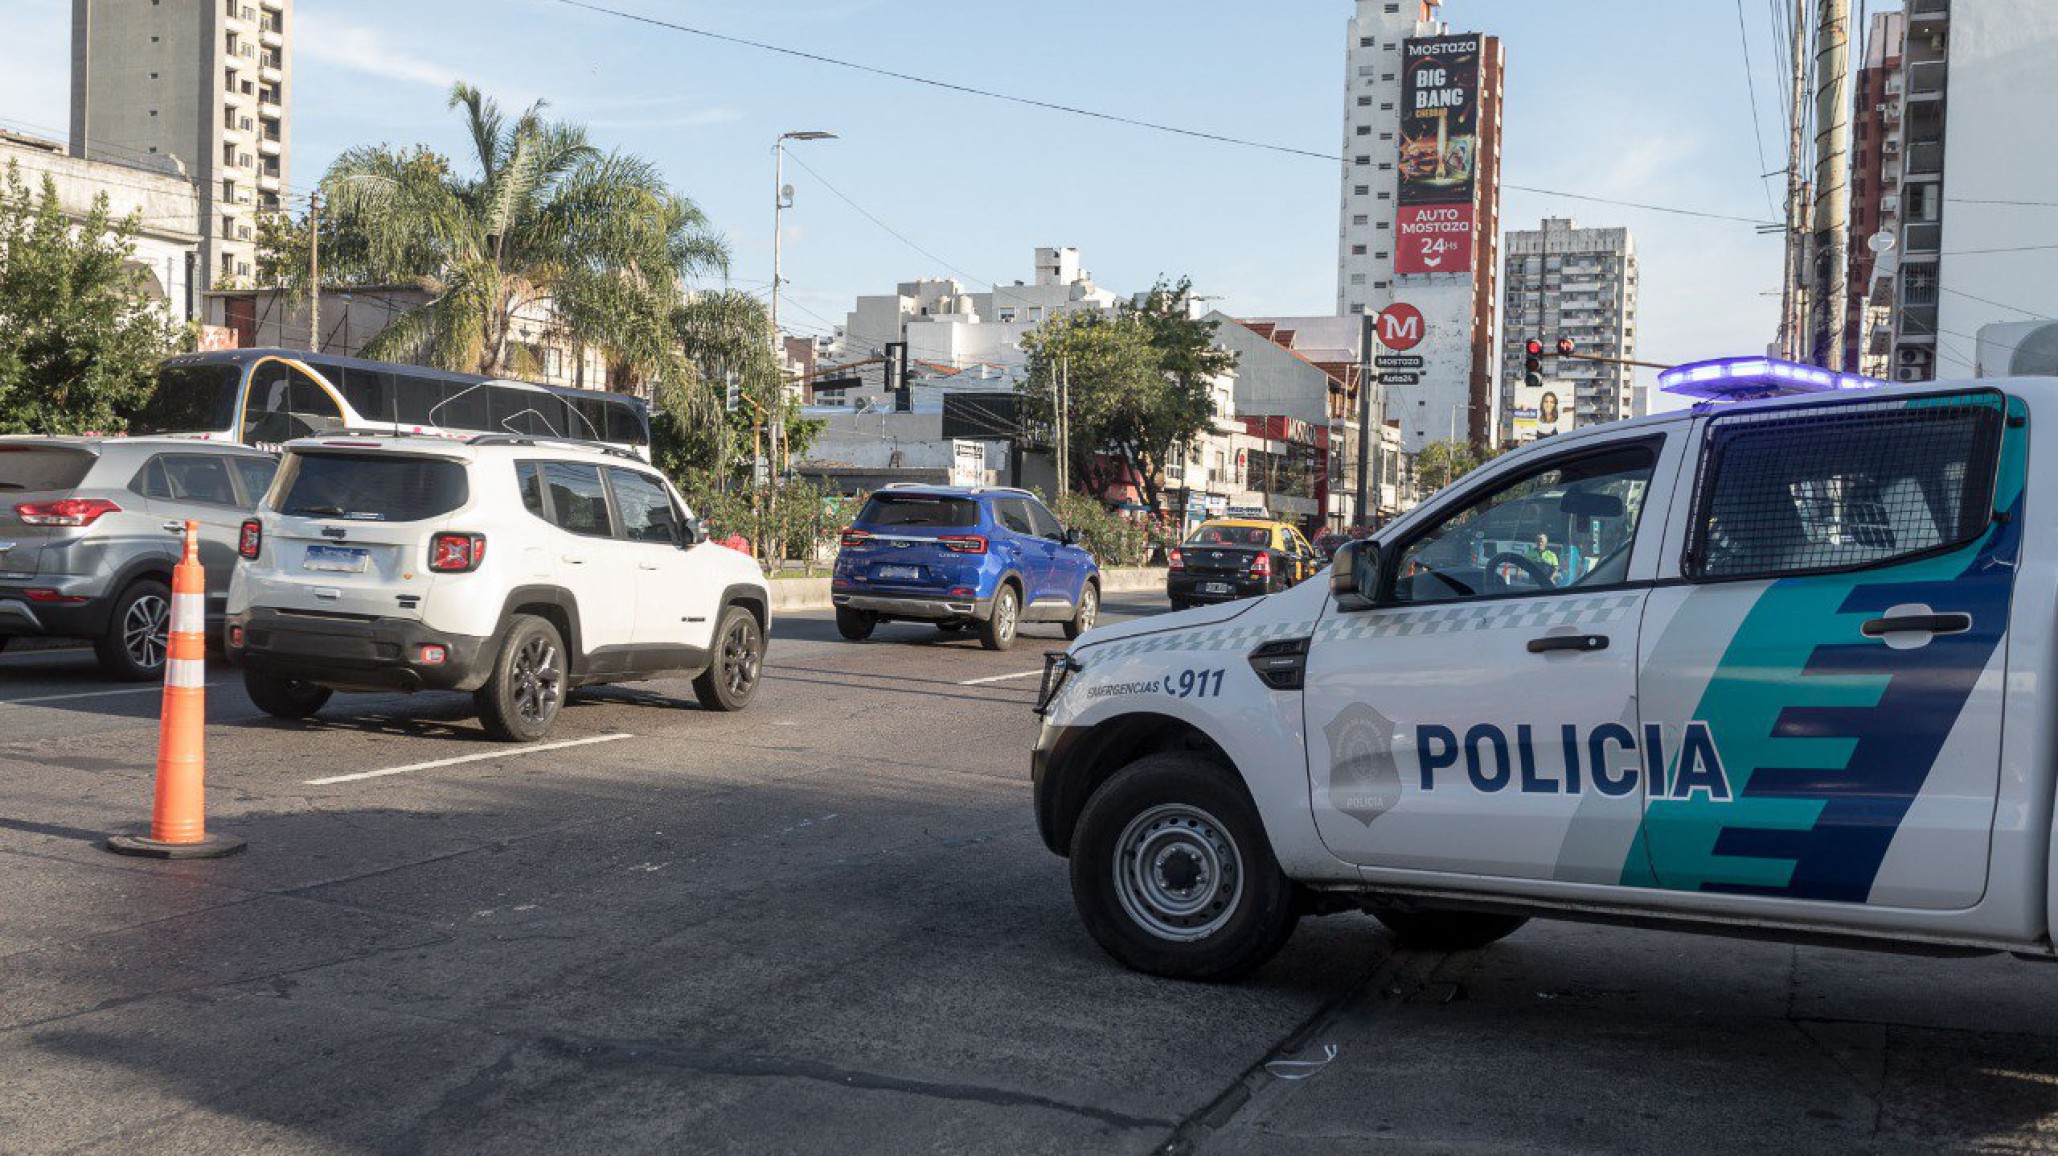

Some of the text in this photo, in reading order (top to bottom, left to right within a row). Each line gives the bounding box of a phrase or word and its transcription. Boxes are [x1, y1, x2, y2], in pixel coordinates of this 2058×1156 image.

[1415, 68, 1446, 88] BIG
[1415, 88, 1464, 109] BANG
[1416, 209, 1459, 222] AUTO
[1383, 313, 1419, 339] M
[1086, 668, 1226, 699] EMERGENCIAS 911
[1415, 720, 1733, 802] POLICIA
[1346, 796, 1383, 808] POLICIA
